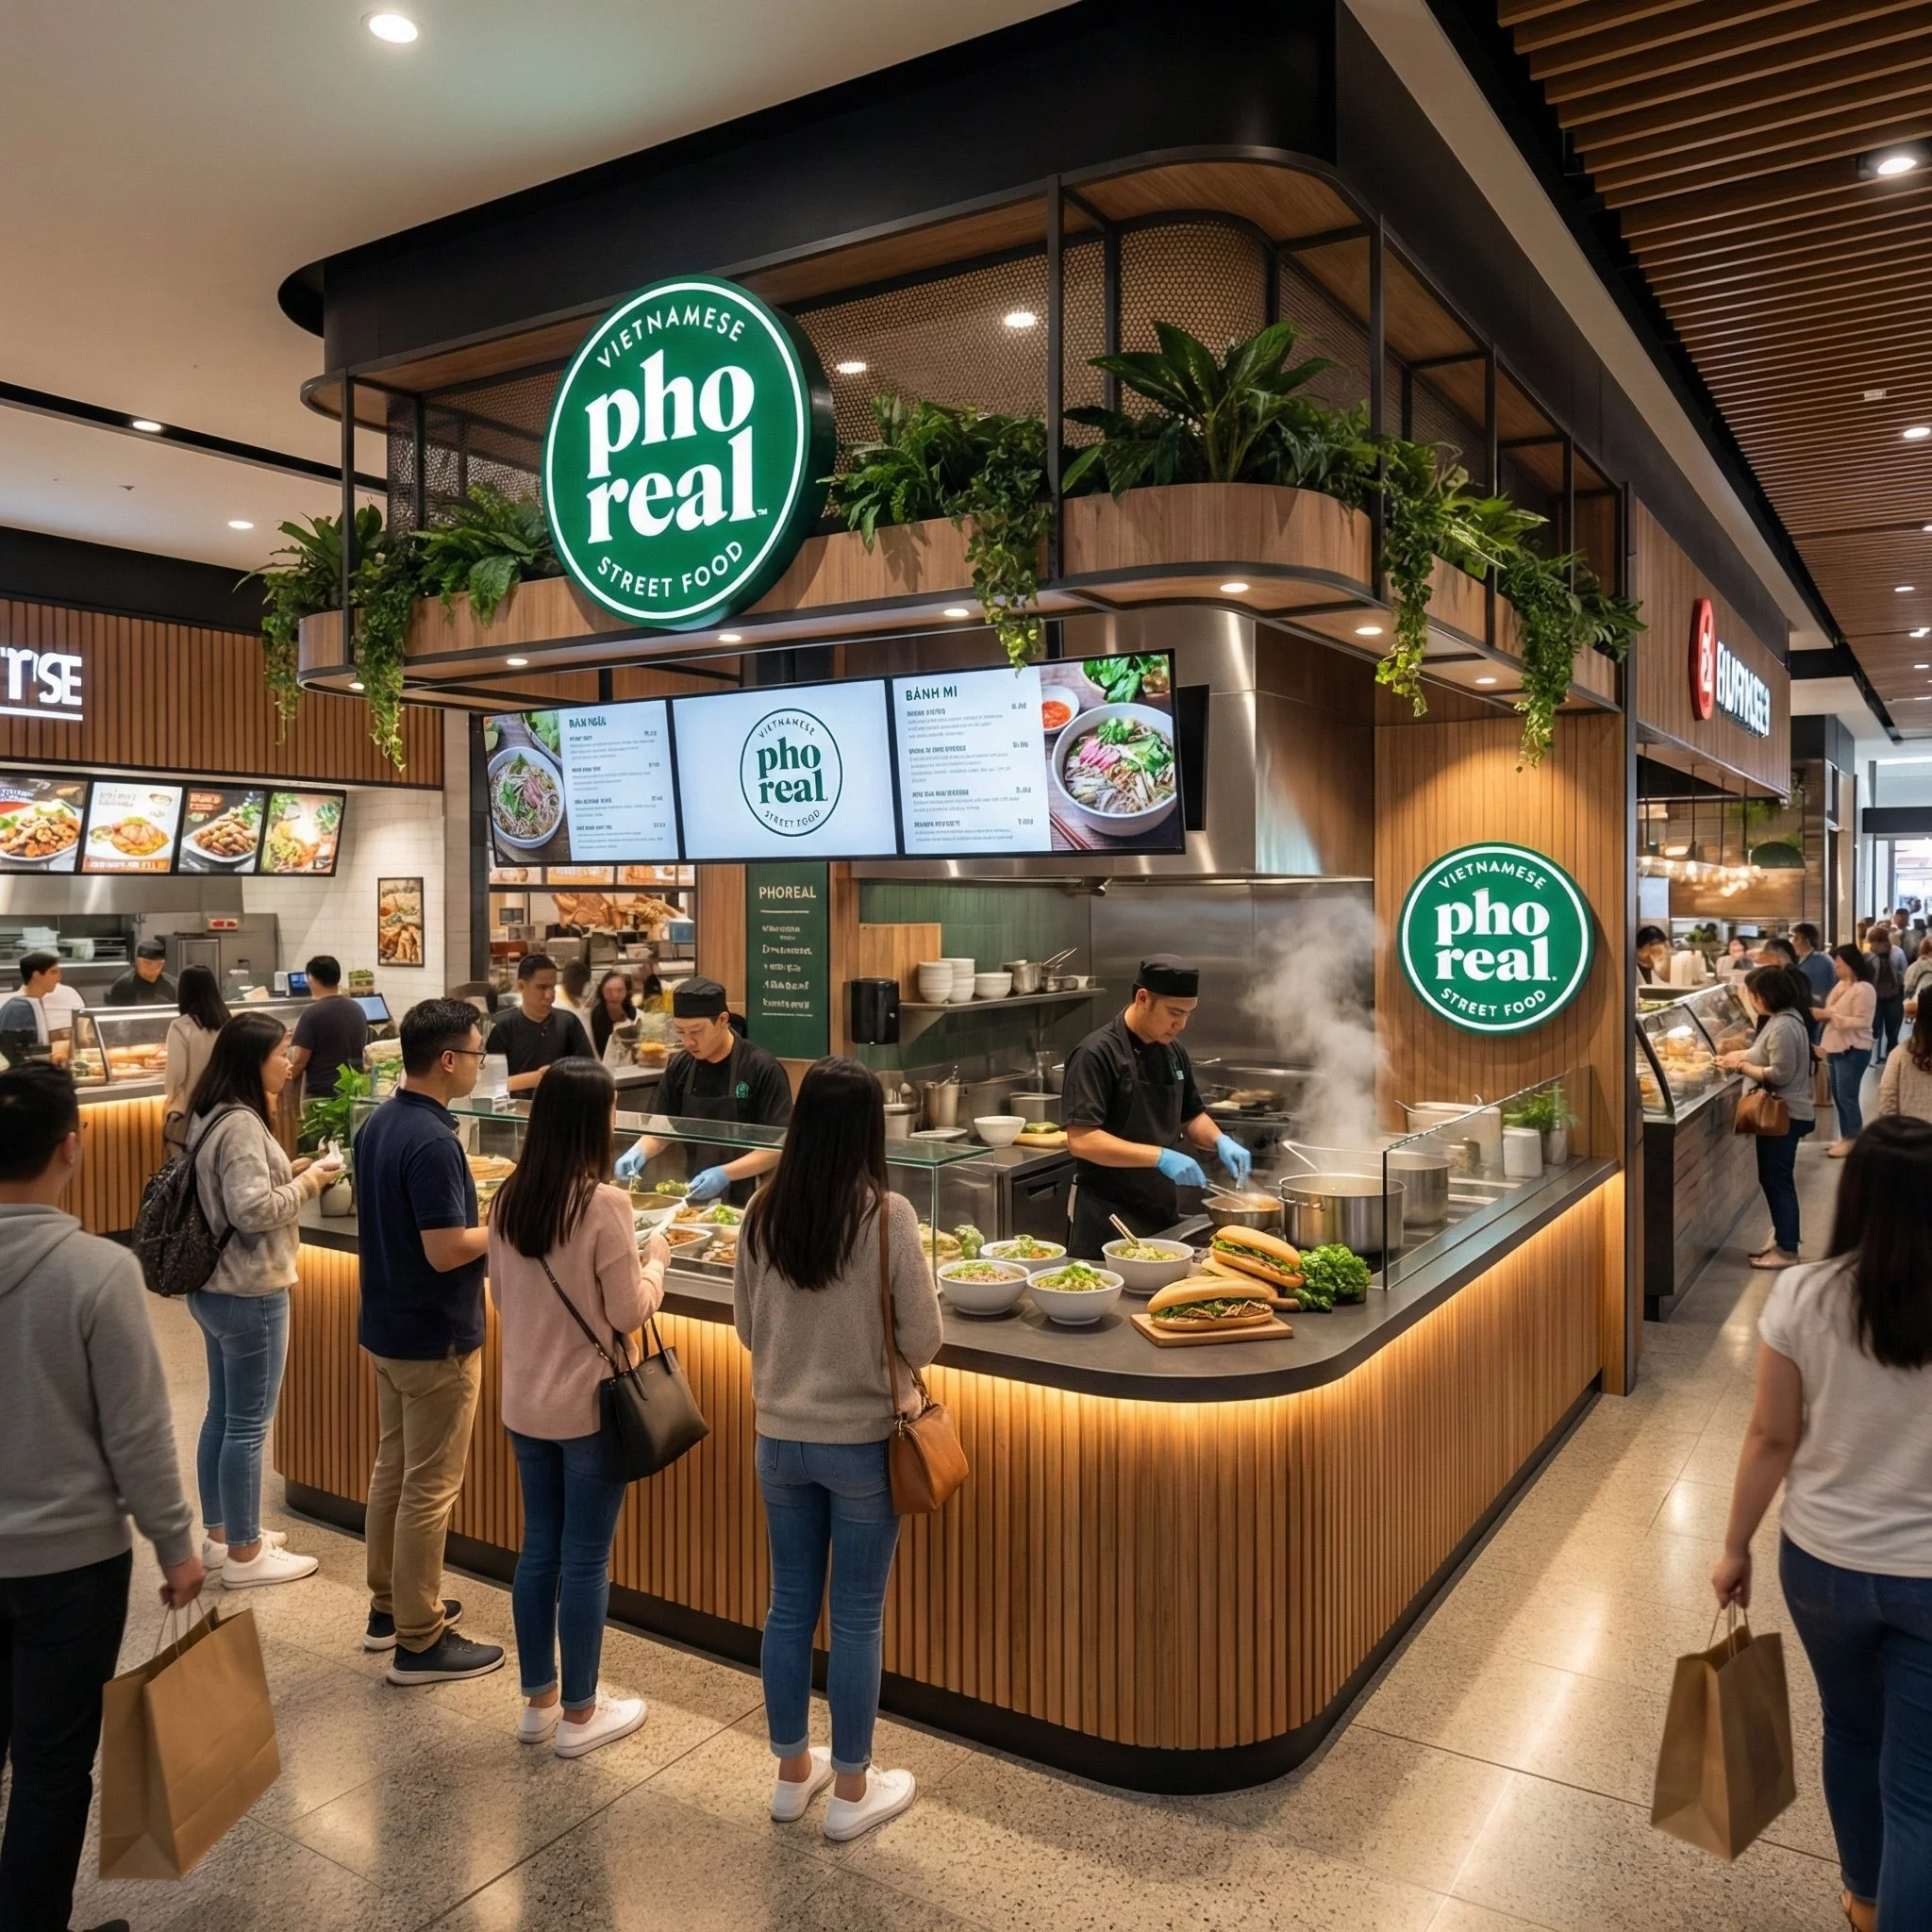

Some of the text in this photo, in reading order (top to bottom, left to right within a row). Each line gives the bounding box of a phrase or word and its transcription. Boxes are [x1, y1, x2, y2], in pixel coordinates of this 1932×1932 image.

[596, 304, 746, 369] VIETNAMESE
[584, 348, 756, 480] pho
[596, 541, 743, 598] STREET FOOD
[756, 736, 822, 781] pho
[758, 768, 828, 805] real
[758, 885, 817, 899] PHOREAL
[1438, 860, 1547, 891] VIETNAMESE
[1433, 887, 1551, 947] pho
[1441, 988, 1547, 1017] STREET FOOD
